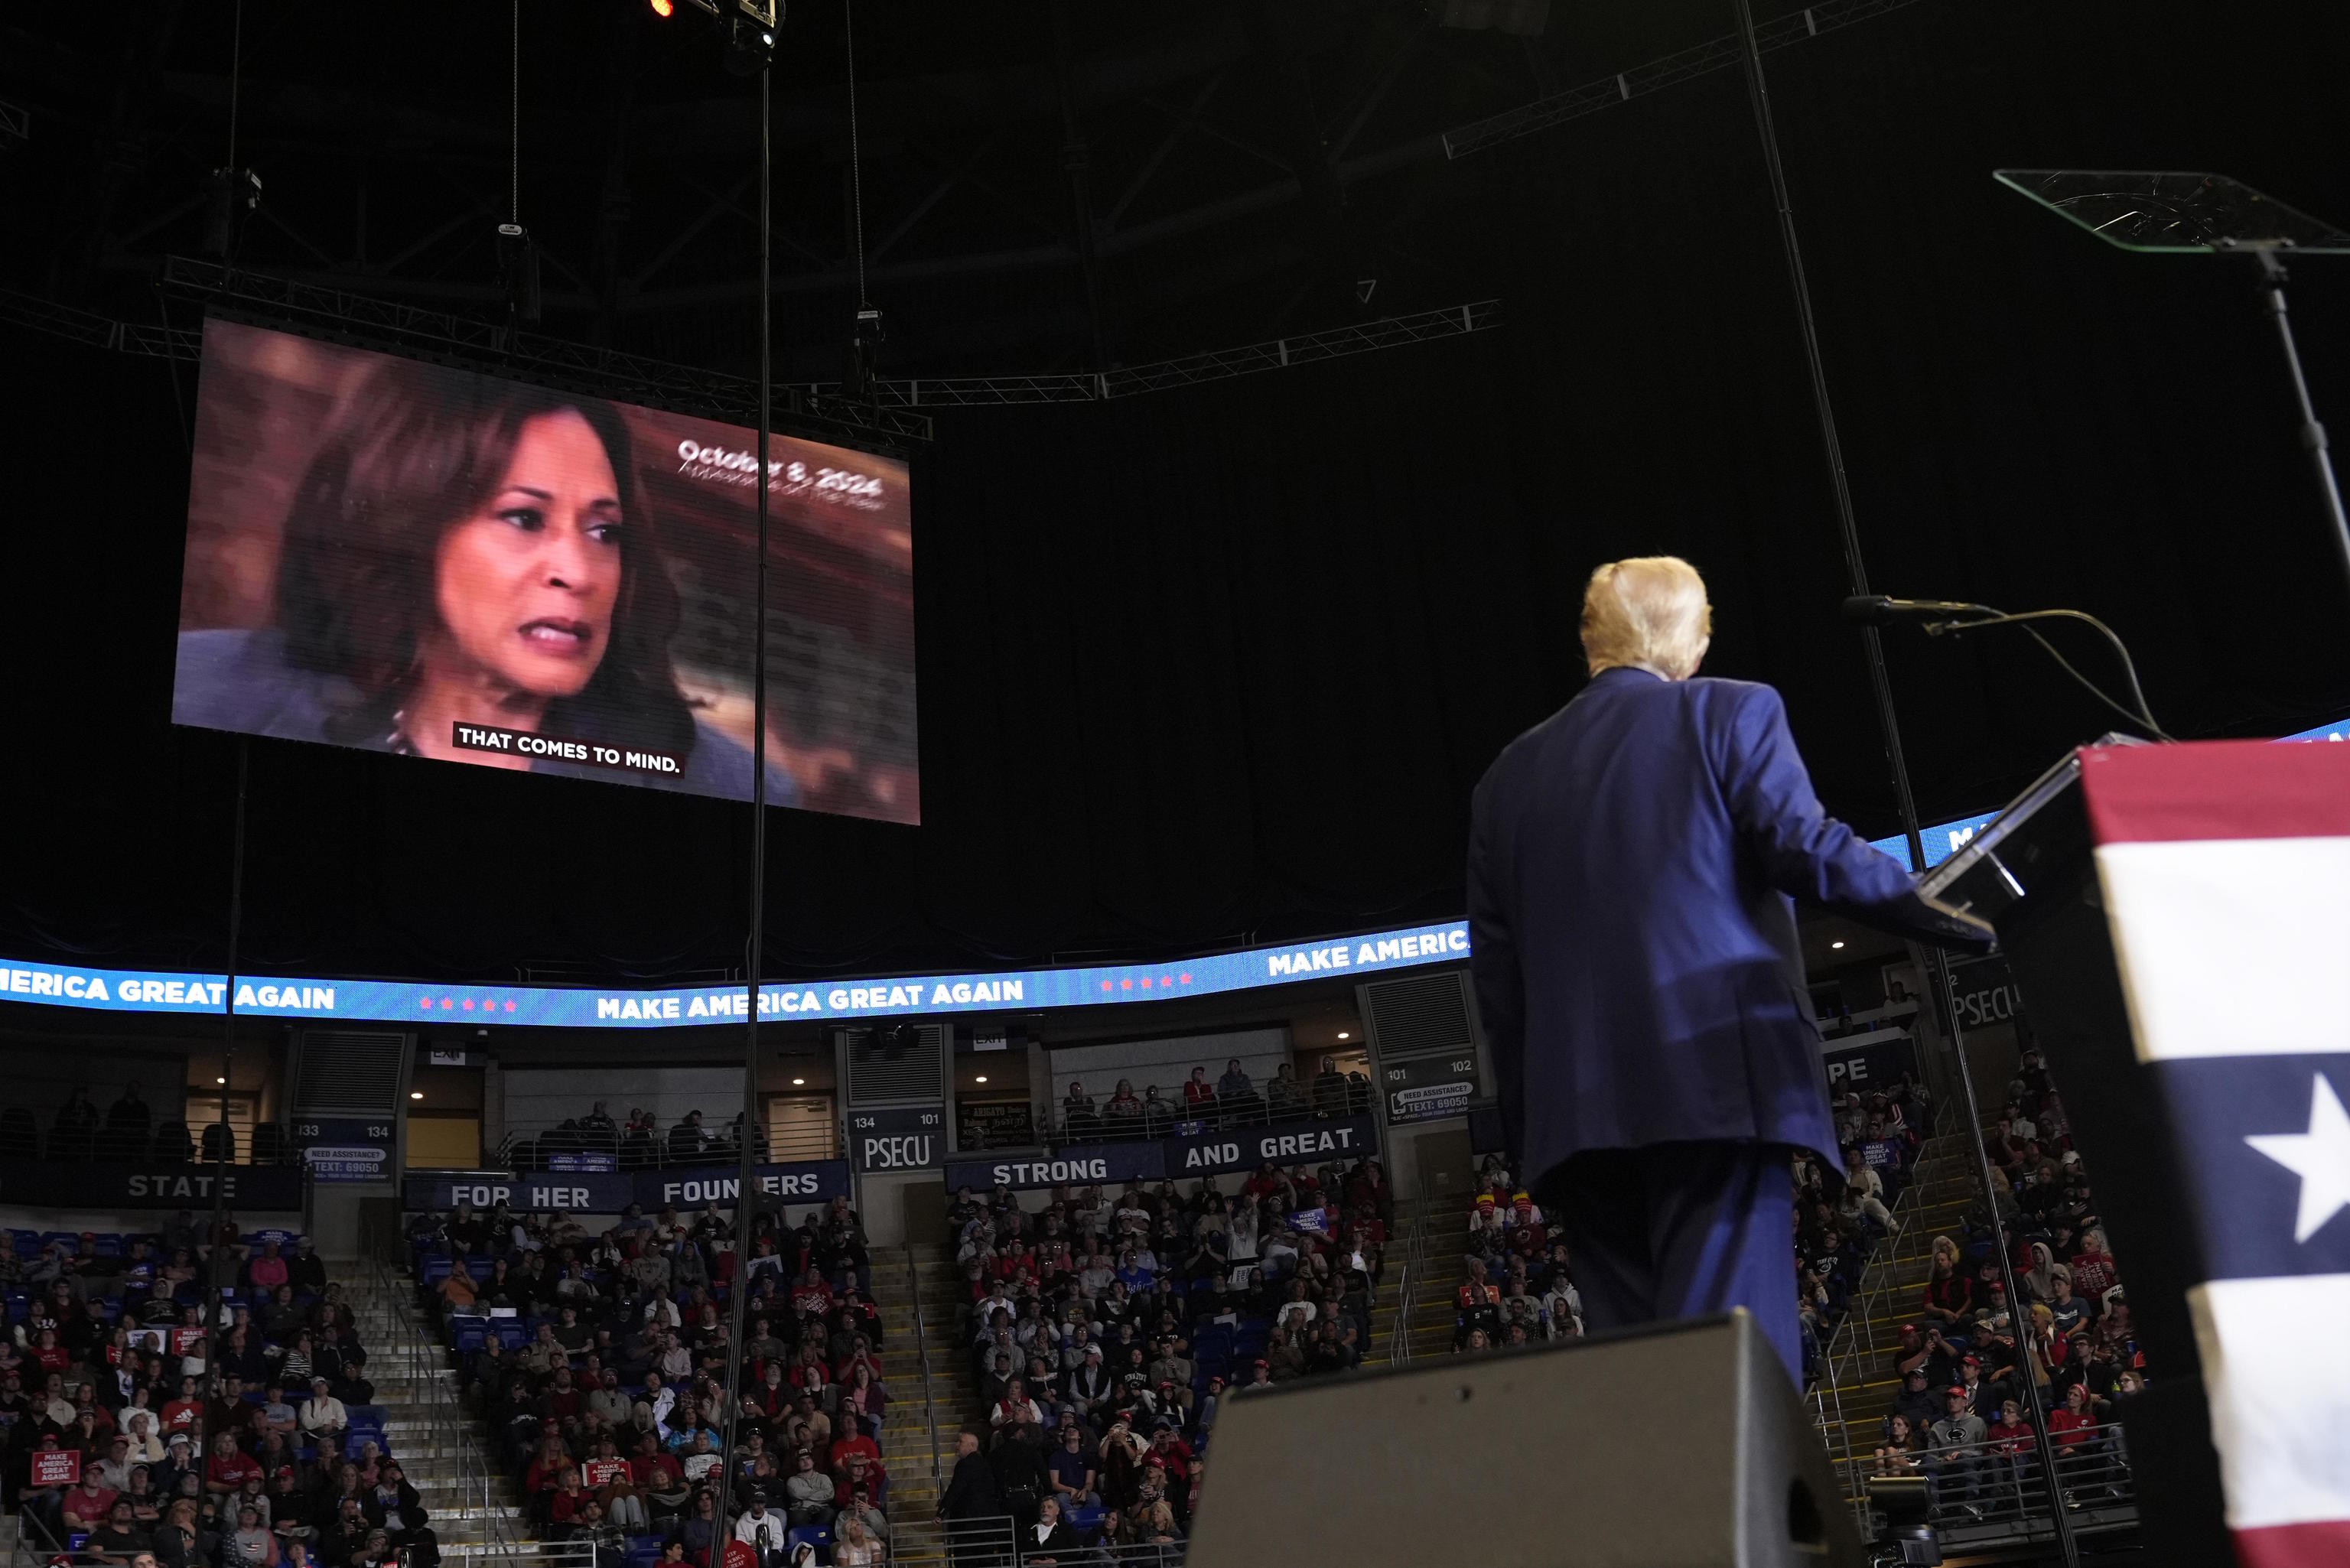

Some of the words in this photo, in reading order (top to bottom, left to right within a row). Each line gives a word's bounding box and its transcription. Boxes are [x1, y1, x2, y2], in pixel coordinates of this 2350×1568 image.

[459, 727, 512, 749] THAT
[517, 737, 588, 760] COMES
[593, 747, 620, 764] TO
[626, 751, 680, 773] MIND.
[1268, 945, 1349, 977] MAKE
[1356, 929, 1470, 965] AMERIC
[118, 979, 226, 1005] GREAT
[233, 984, 335, 1010] AGAIN
[597, 997, 680, 1020] MAKE
[687, 991, 822, 1018] AMERICA
[828, 984, 923, 1010] GREAT
[931, 980, 1024, 1005] AGAIN
[1387, 1069, 1407, 1081] 101
[1451, 1059, 1473, 1072] 102
[1404, 1091, 1421, 1100] NEED
[1423, 1085, 1467, 1097] ASSISTANCE?
[1408, 1100, 1434, 1113] TEXT:
[1437, 1096, 1468, 1109] 69050
[366, 1126, 389, 1138] 134
[853, 1117, 876, 1129] 134
[920, 1113, 939, 1125] 101
[332, 1150, 380, 1159] ASSISTANCE?
[864, 1135, 930, 1169] PSECU
[1185, 1142, 1240, 1169] AND
[1260, 1127, 1361, 1159] GREAT.
[314, 1162, 343, 1172] TEXT:
[346, 1163, 379, 1173] 69050
[992, 1158, 1108, 1185] STRONG
[128, 1174, 236, 1198] STATE
[451, 1186, 511, 1207] FOR
[532, 1186, 591, 1208] HER
[663, 1173, 819, 1203] FOUNERS
[37, 1459, 74, 1469] AMERICA
[41, 1466, 70, 1475] GREAT
